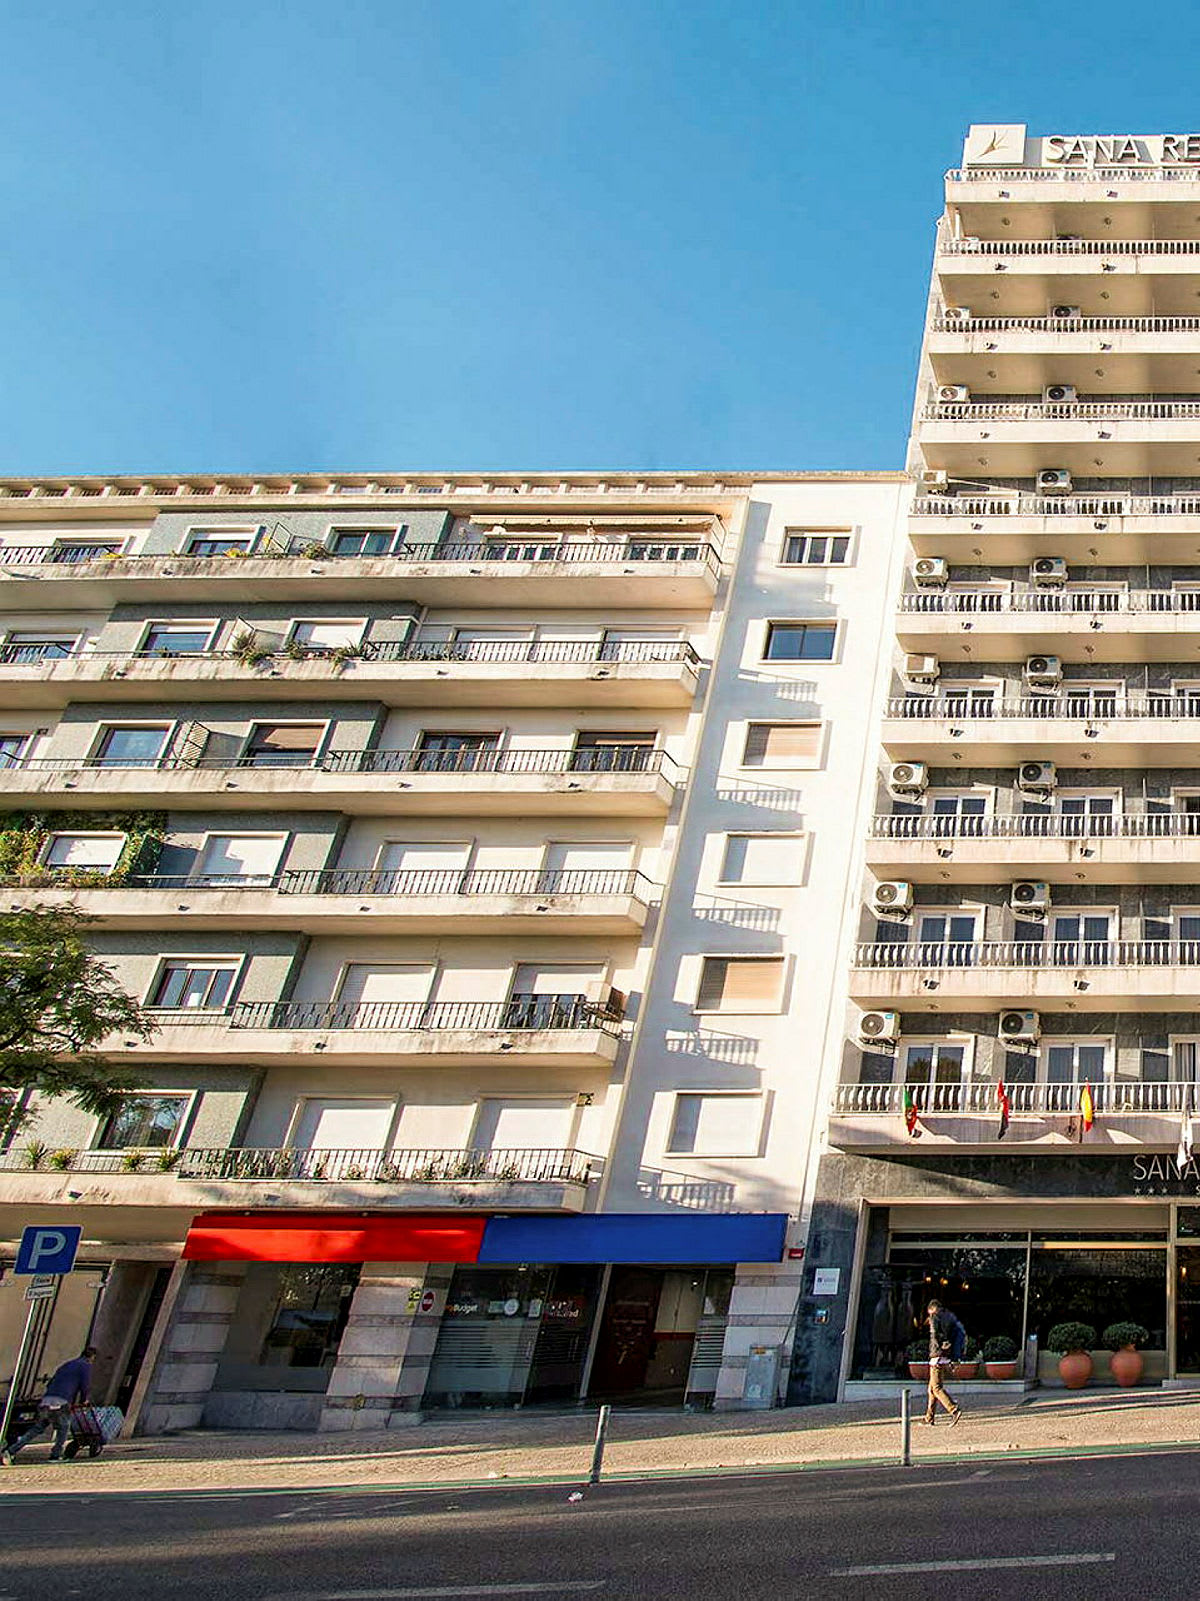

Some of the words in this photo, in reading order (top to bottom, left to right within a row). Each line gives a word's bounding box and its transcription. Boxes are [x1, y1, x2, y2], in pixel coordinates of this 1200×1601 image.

[1045, 135, 1140, 162] SANA
[1133, 1154, 1200, 1181] SANA
[27, 1230, 67, 1270] P
